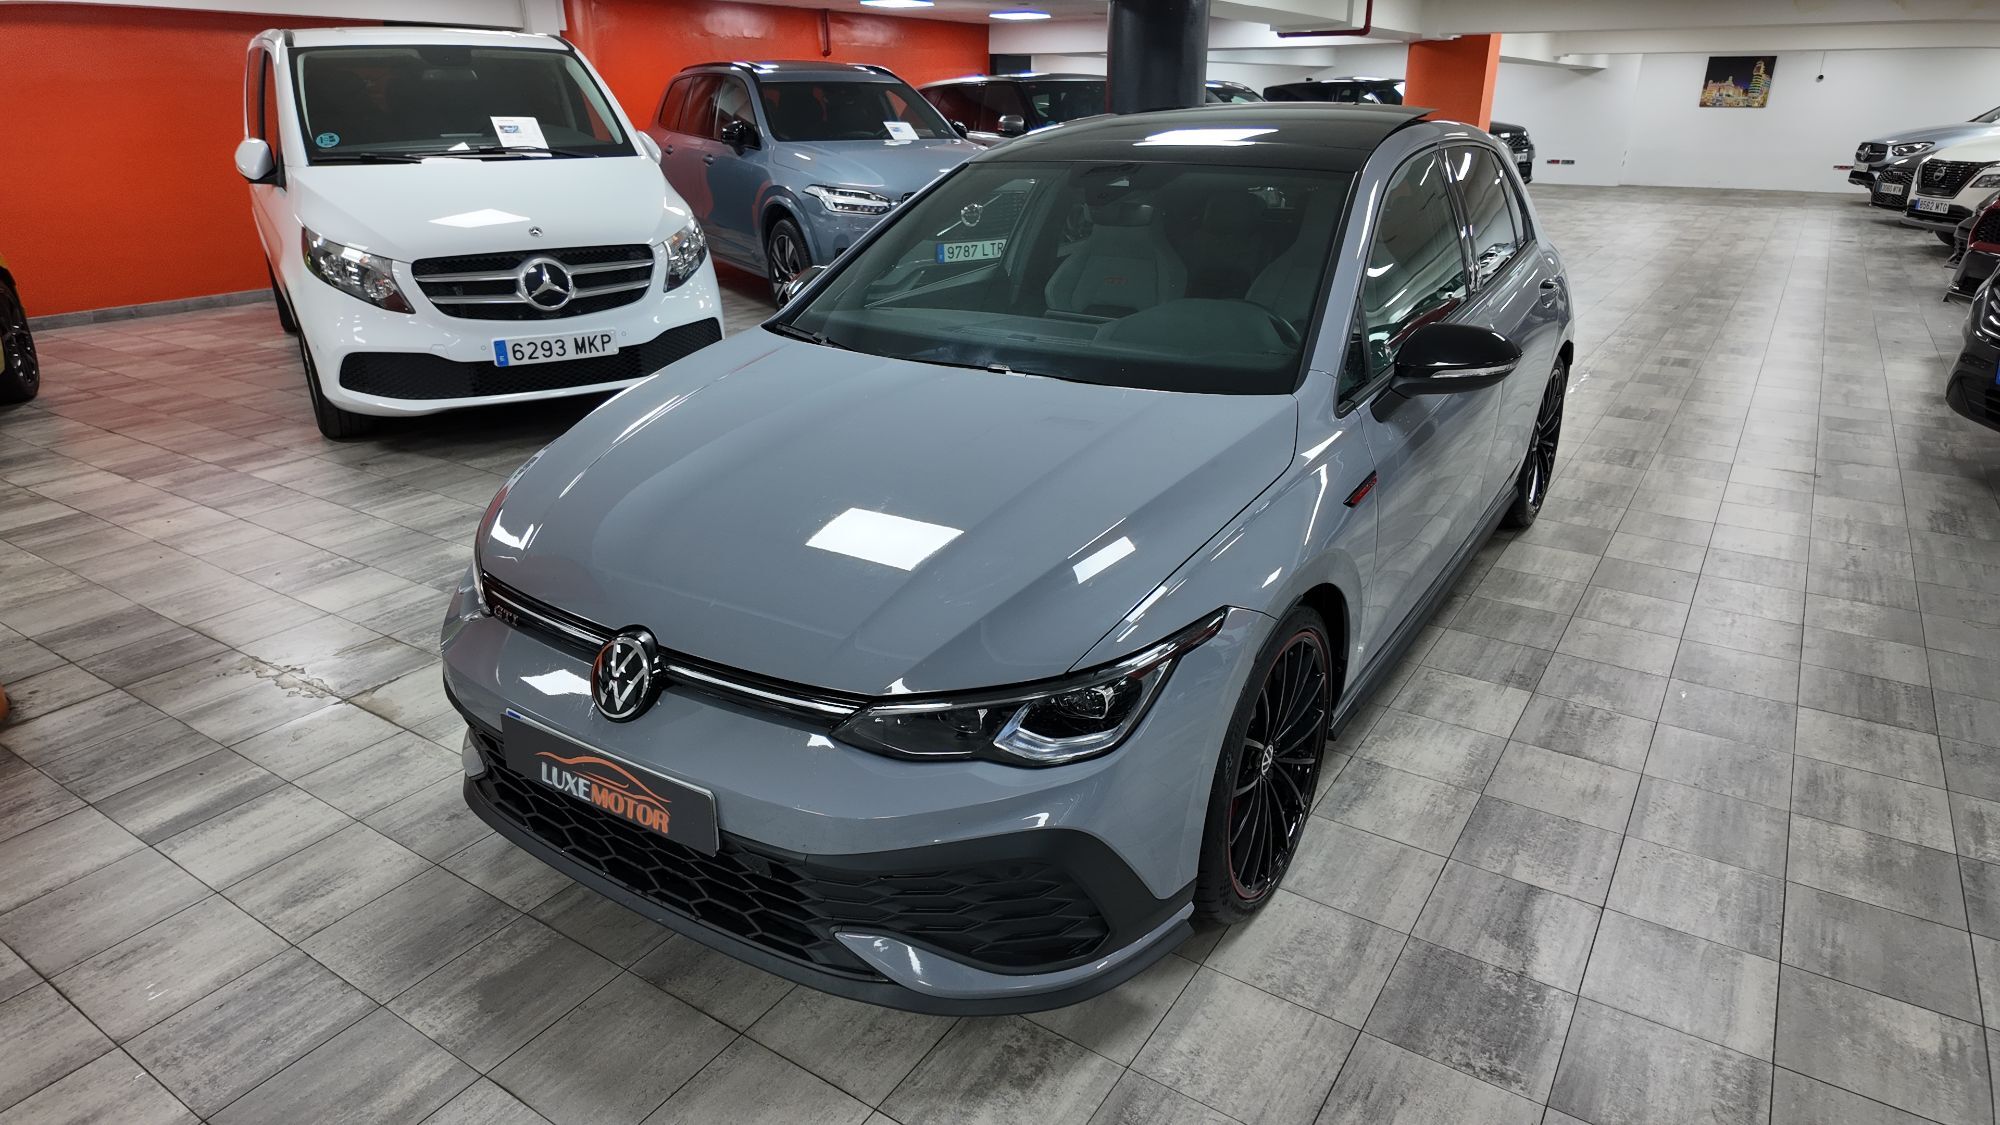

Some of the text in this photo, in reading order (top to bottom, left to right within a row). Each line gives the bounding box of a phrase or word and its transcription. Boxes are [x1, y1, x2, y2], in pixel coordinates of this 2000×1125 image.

[1935, 202, 1948, 213] MTG
[947, 244, 978, 259] 9787
[511, 334, 611, 361] 6293 MKP
[494, 605, 519, 626] GTI
